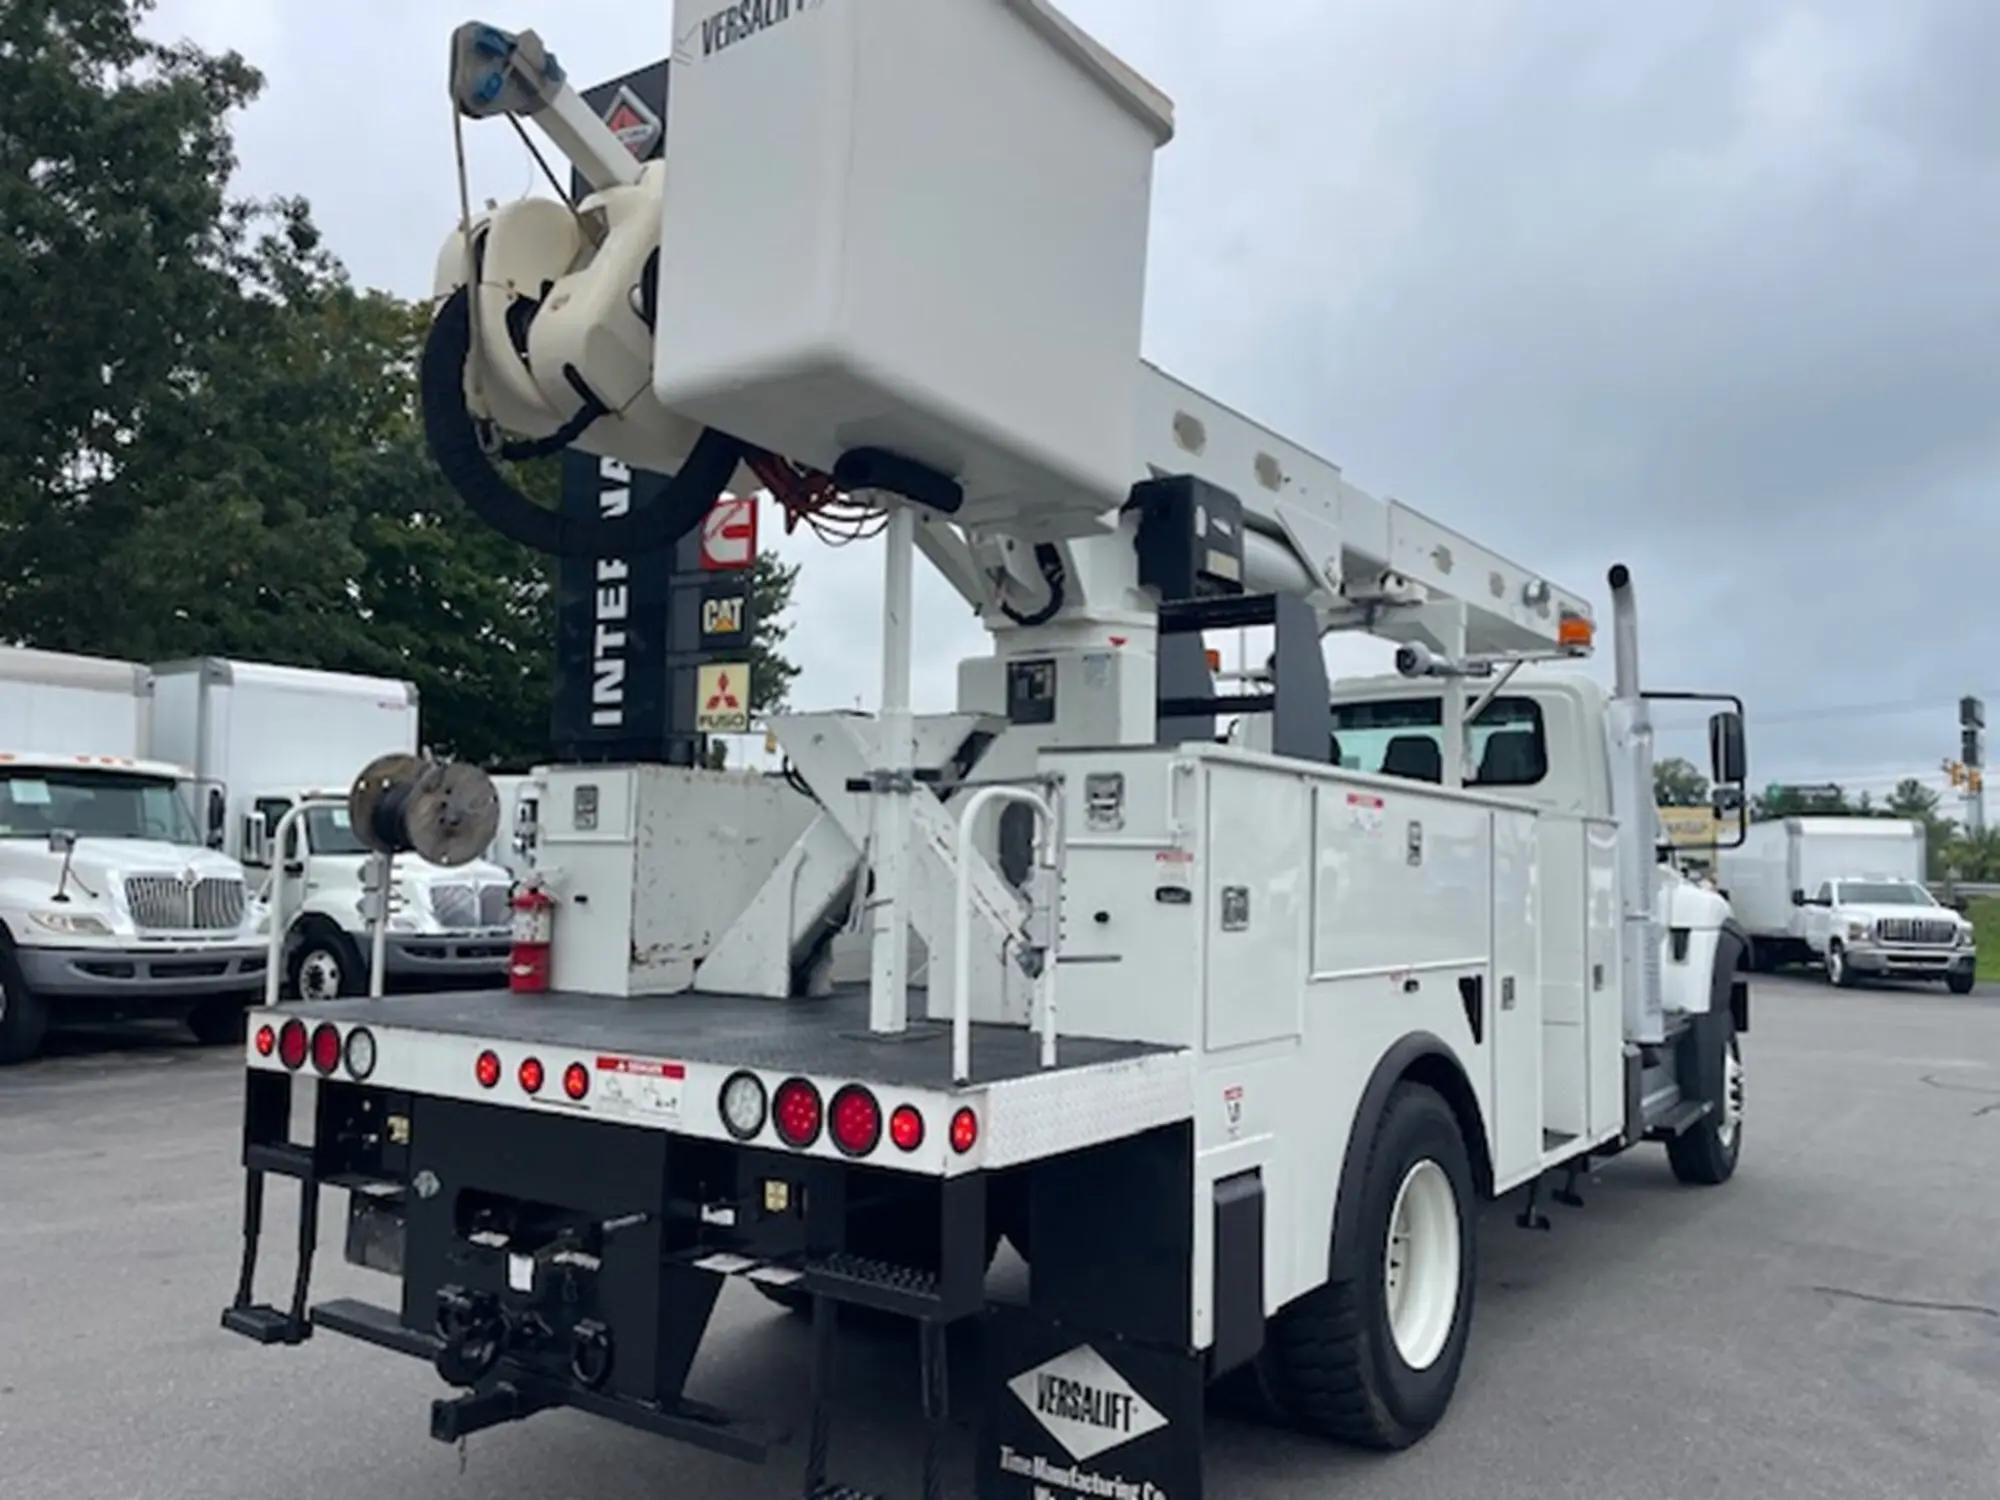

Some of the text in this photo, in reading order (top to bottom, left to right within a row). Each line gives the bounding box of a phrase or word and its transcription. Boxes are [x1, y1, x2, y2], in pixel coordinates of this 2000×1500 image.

[703, 598, 744, 633] CAT
[1037, 1372, 1133, 1432] VERSALIFT
[1000, 1444, 1032, 1475] Time
[1033, 1455, 1140, 1500] Manufacturing
